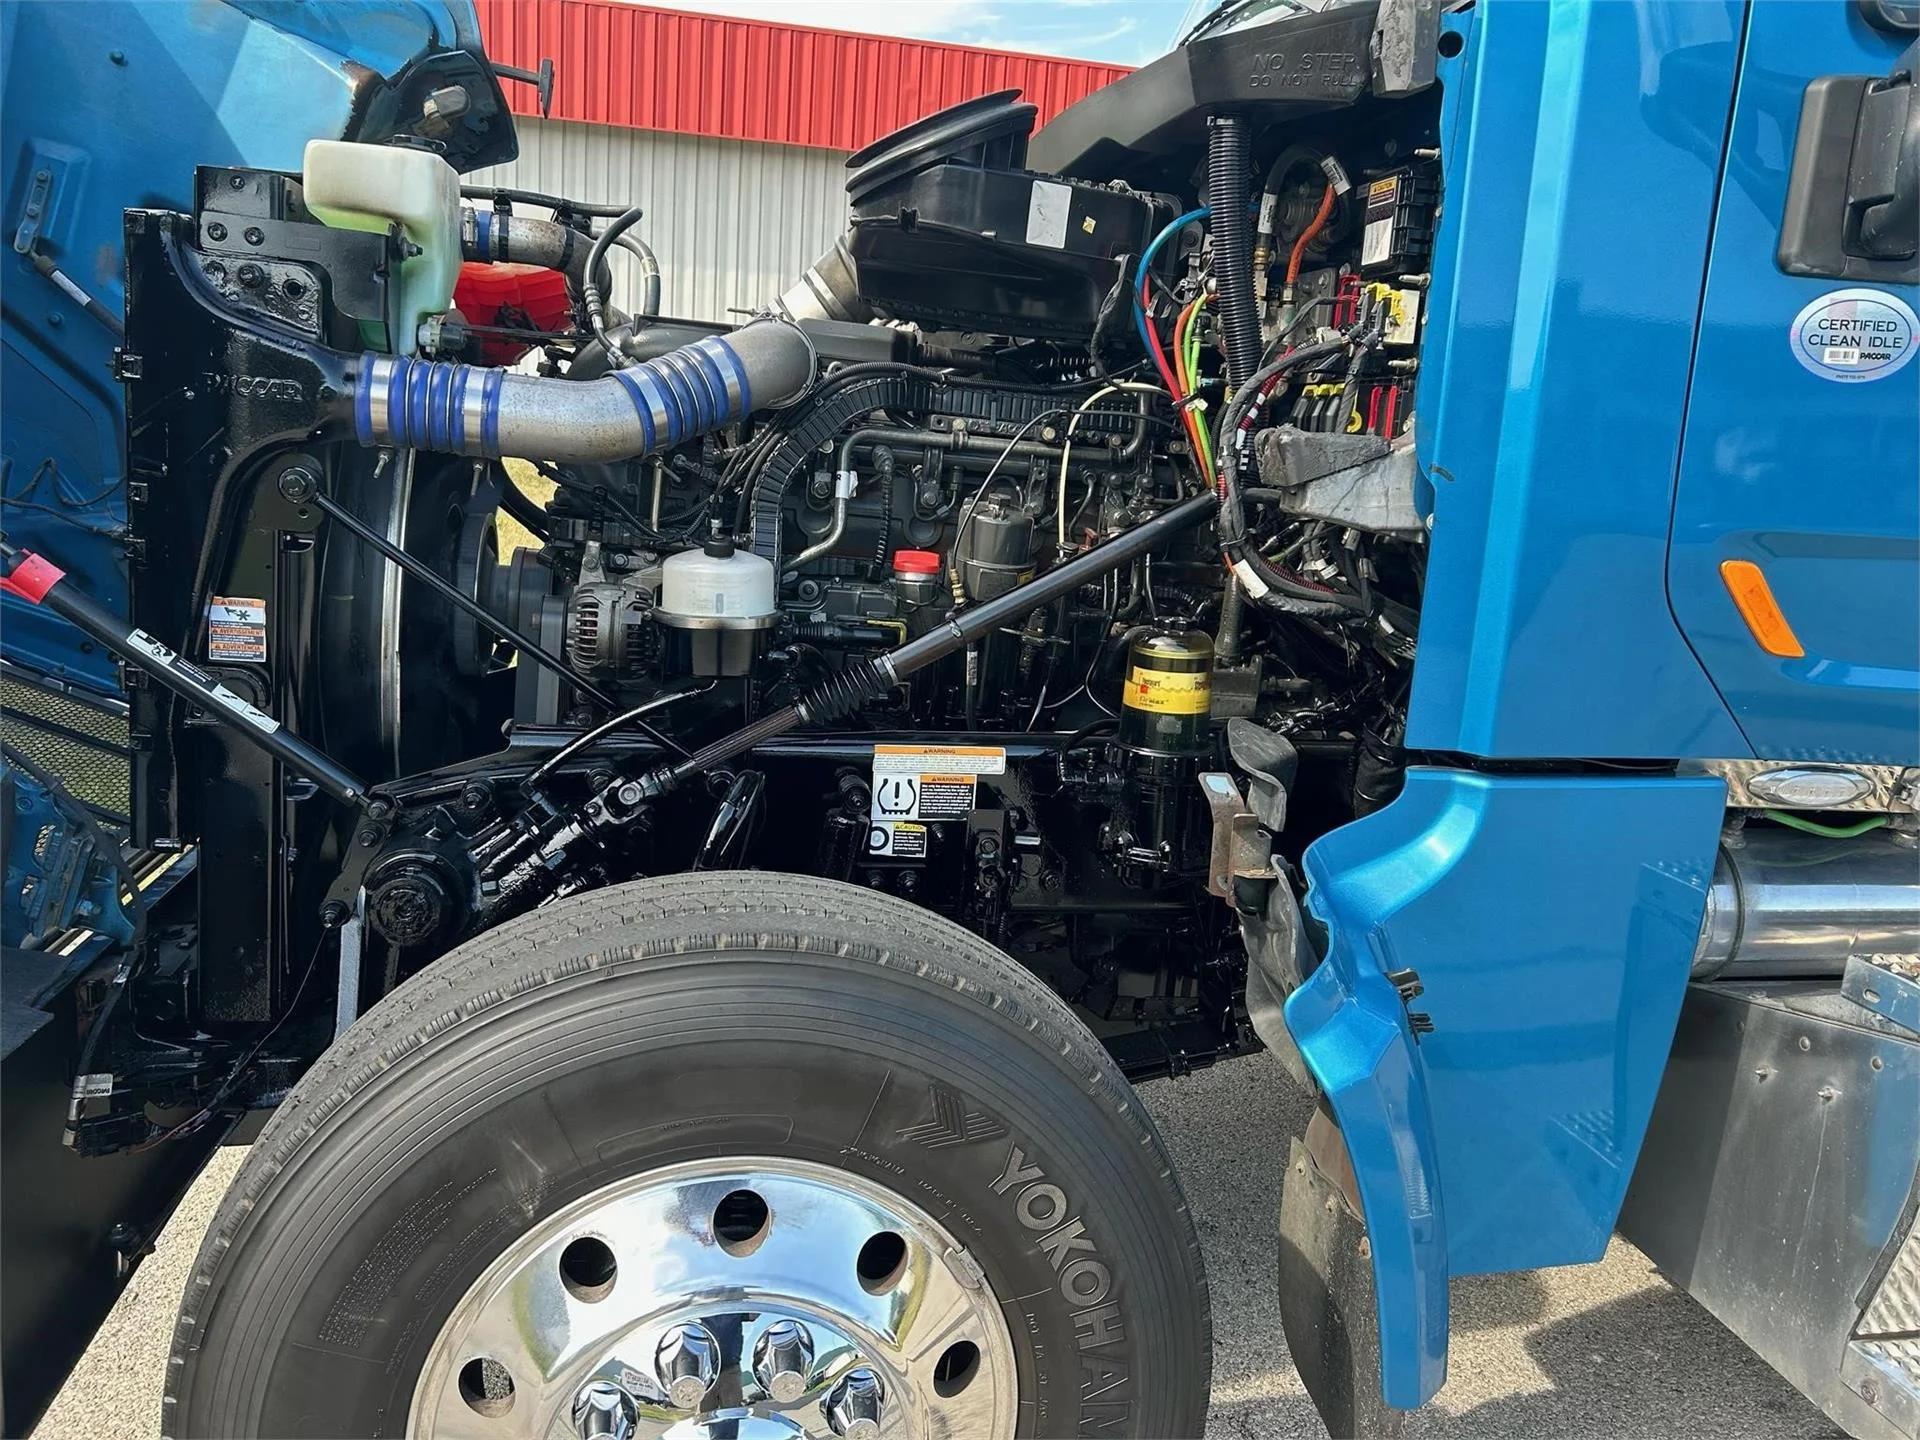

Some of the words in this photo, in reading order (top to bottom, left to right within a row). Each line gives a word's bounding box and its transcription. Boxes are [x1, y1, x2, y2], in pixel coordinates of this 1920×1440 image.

[1252, 53, 1285, 72] NO
[1300, 52, 1356, 71] STEP
[1249, 75, 1272, 88] DO
[1280, 74, 1312, 87] NOT
[1322, 73, 1358, 87] PULL
[1818, 318, 1898, 332] CERTIFIED
[1808, 334, 1861, 347] CLEAN
[1868, 336, 1903, 348] IDLE
[1859, 352, 1891, 361] PACCAR
